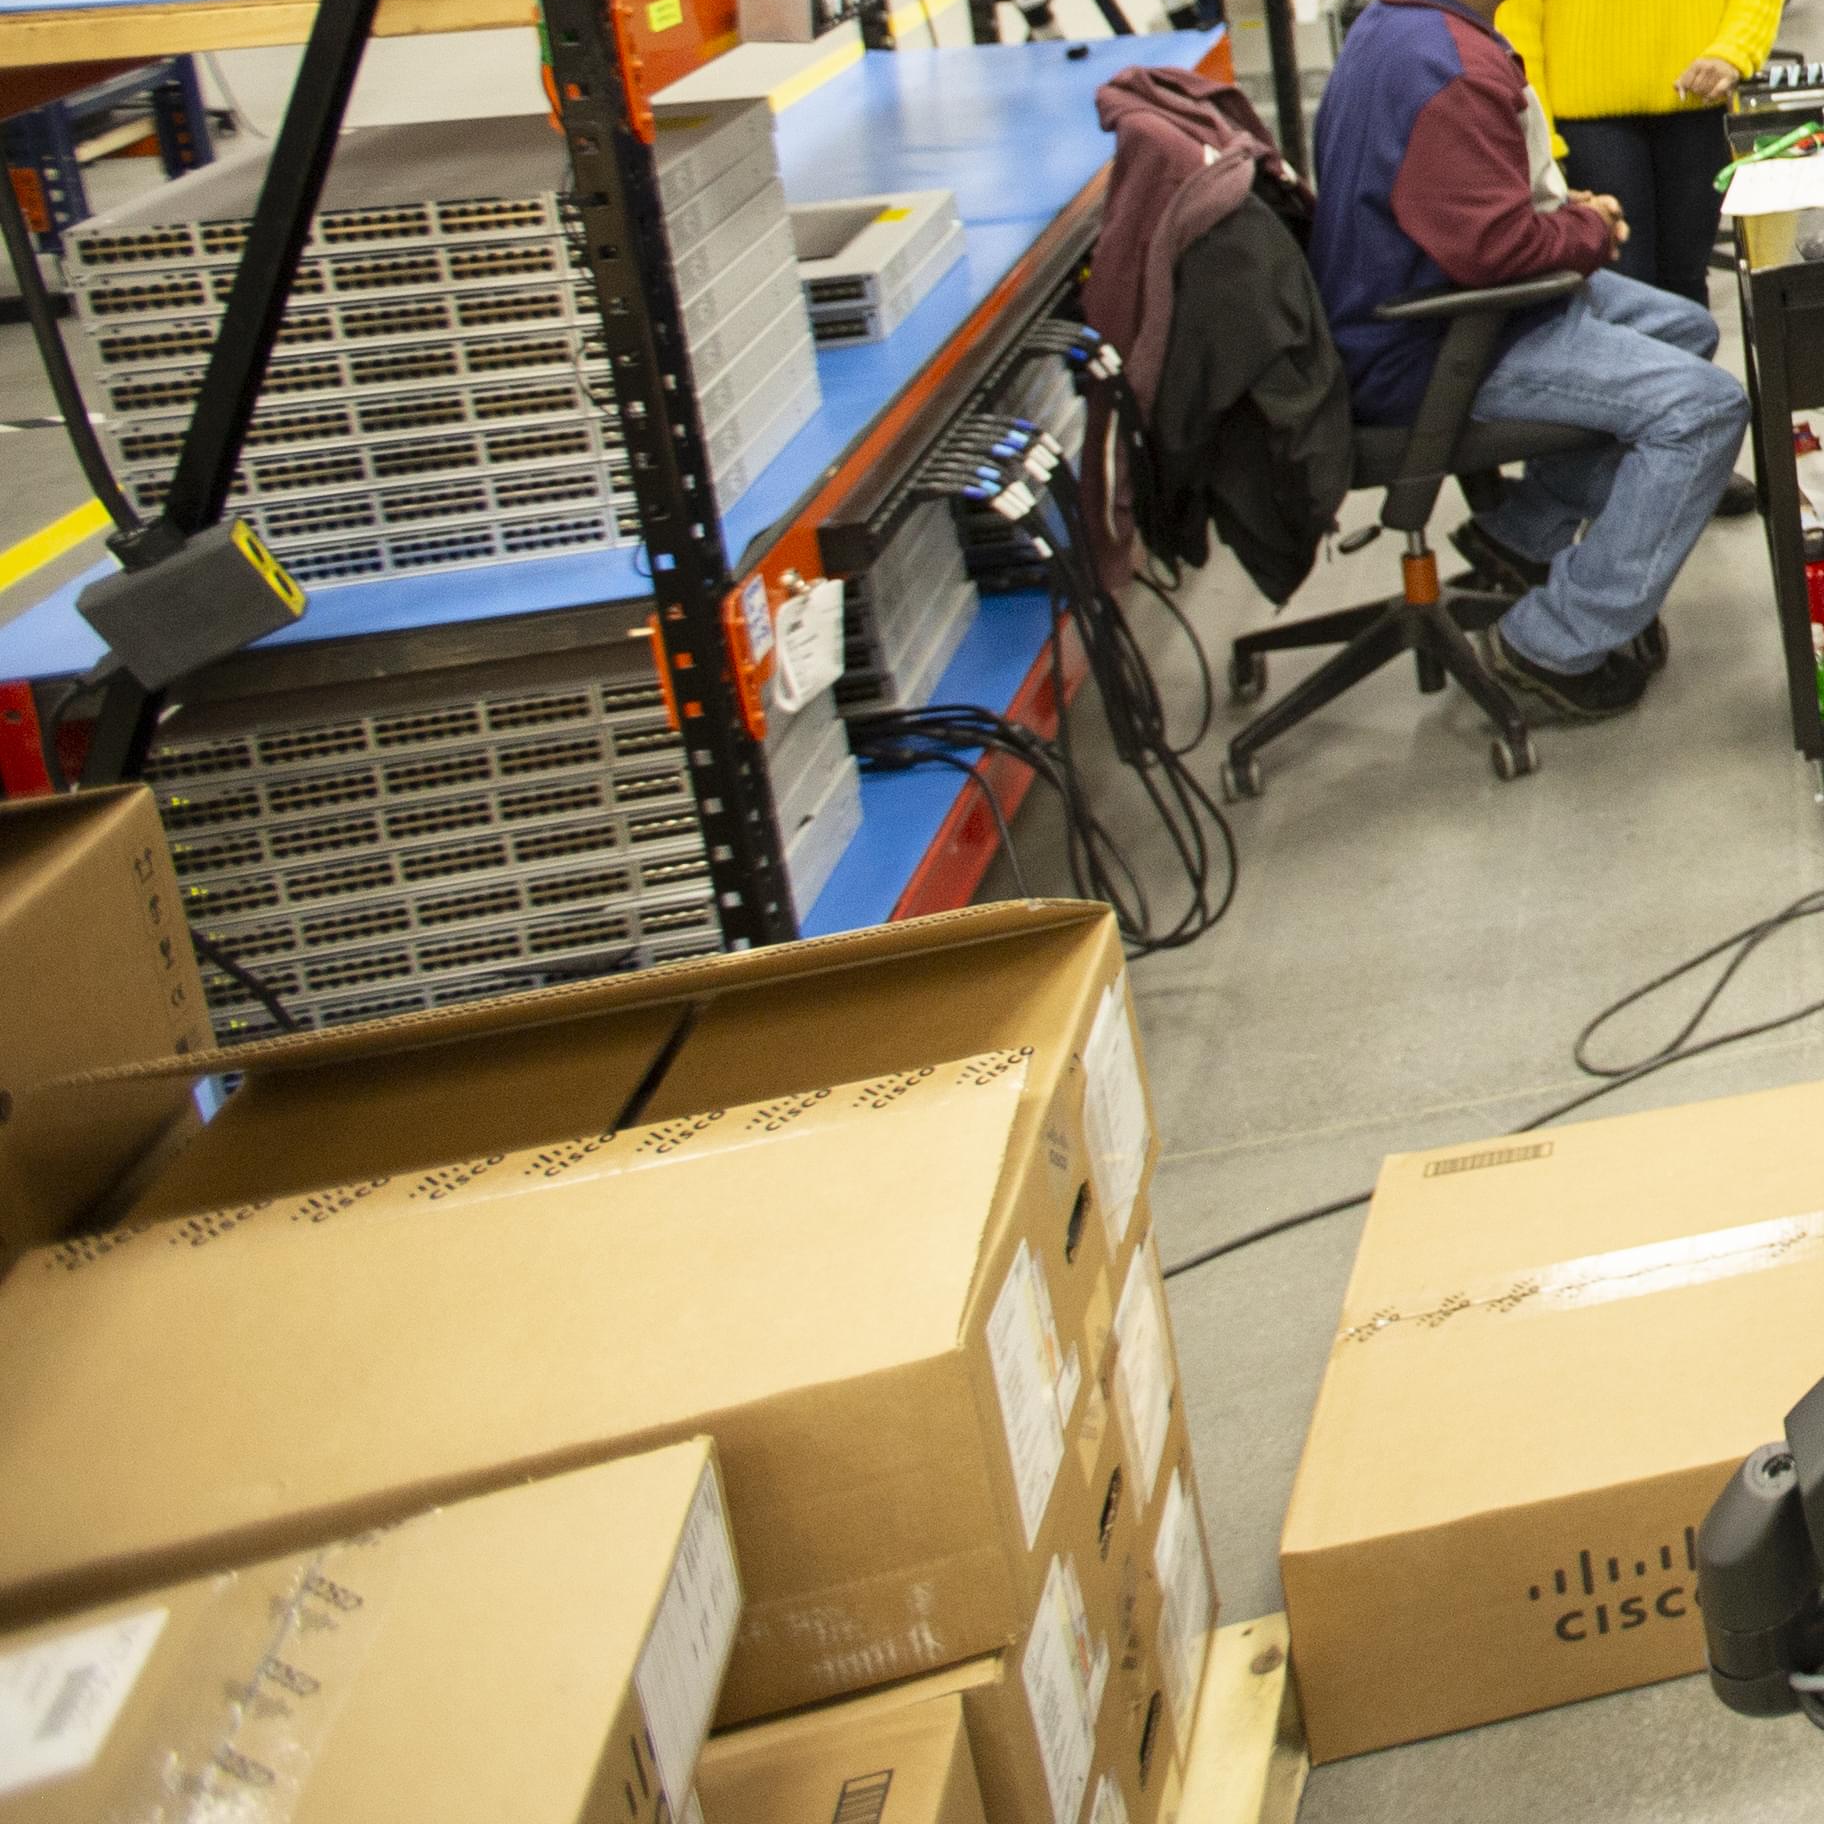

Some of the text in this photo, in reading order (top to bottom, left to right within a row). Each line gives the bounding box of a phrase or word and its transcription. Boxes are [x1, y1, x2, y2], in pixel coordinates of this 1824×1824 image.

[871, 1066, 937, 1110] CISCO
[975, 1045, 1035, 1086] CISCO
[656, 1107, 727, 1155] CISCO
[763, 1087, 834, 1133] CISCO
[544, 1130, 618, 1178] CISCO
[1555, 1586, 1702, 1642] CISC
